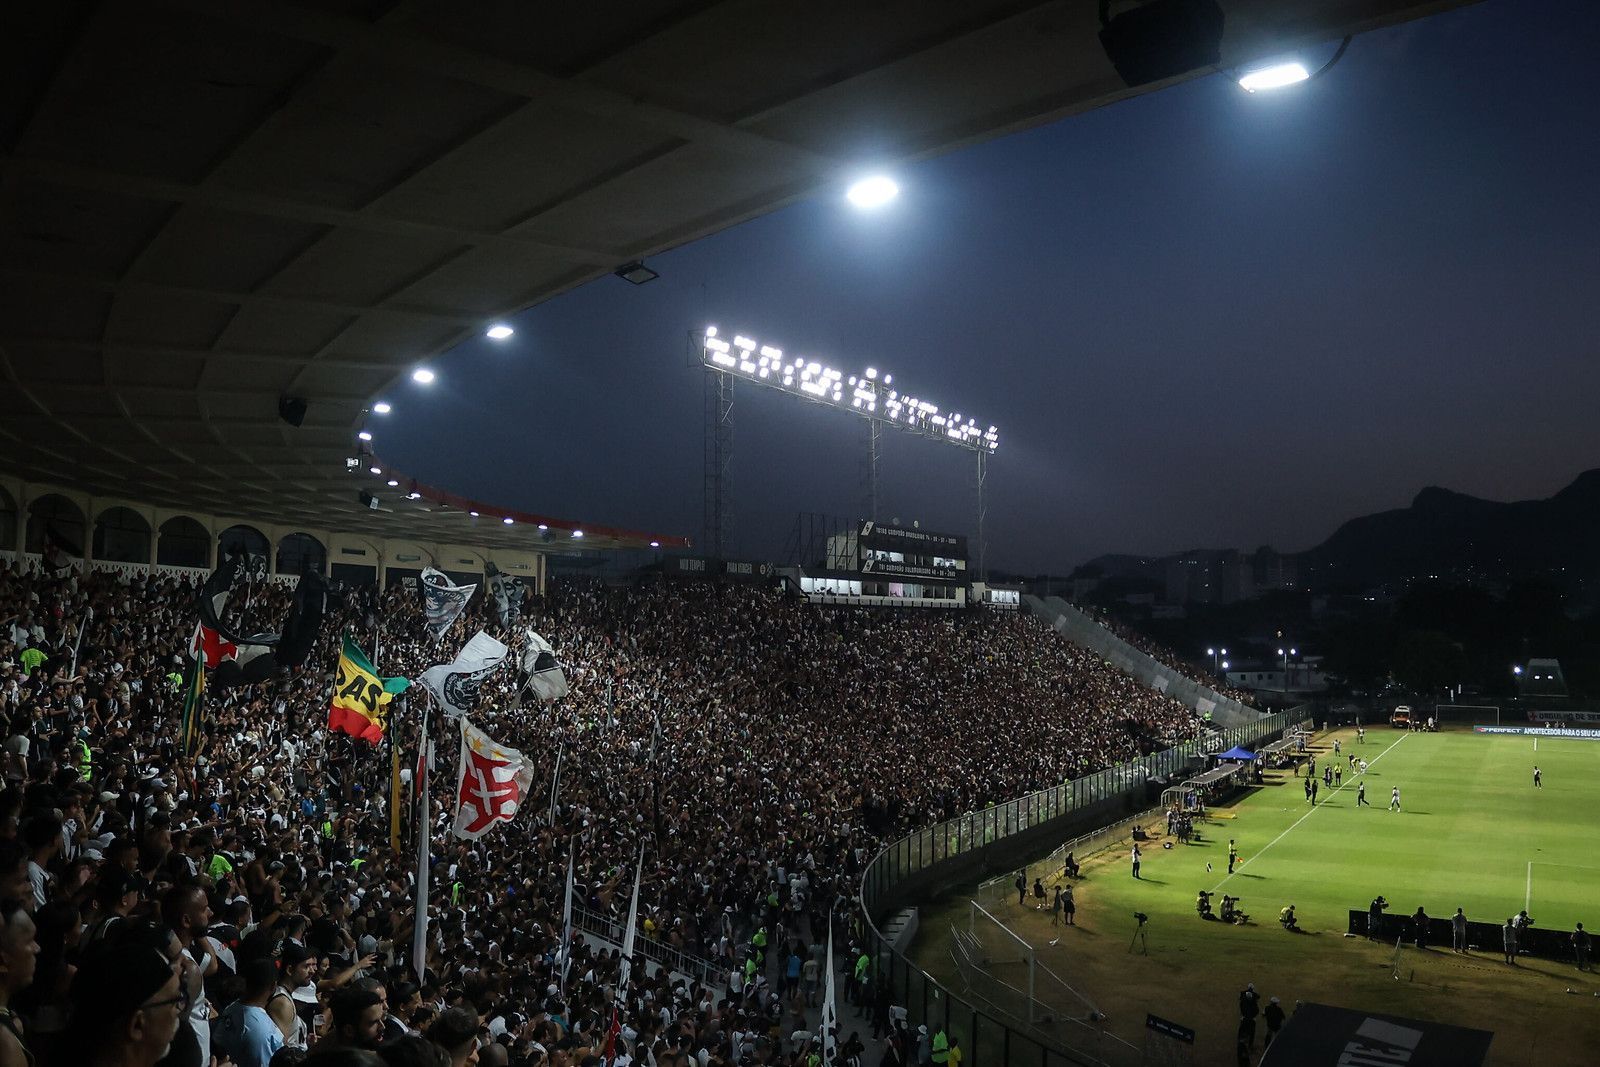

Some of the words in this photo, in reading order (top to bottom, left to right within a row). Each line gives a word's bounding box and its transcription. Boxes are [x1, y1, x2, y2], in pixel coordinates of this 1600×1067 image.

[1523, 727, 1561, 735] AMORTECEDOR
[1561, 728, 1575, 736] PARA
[1581, 729, 1591, 737] SEU
